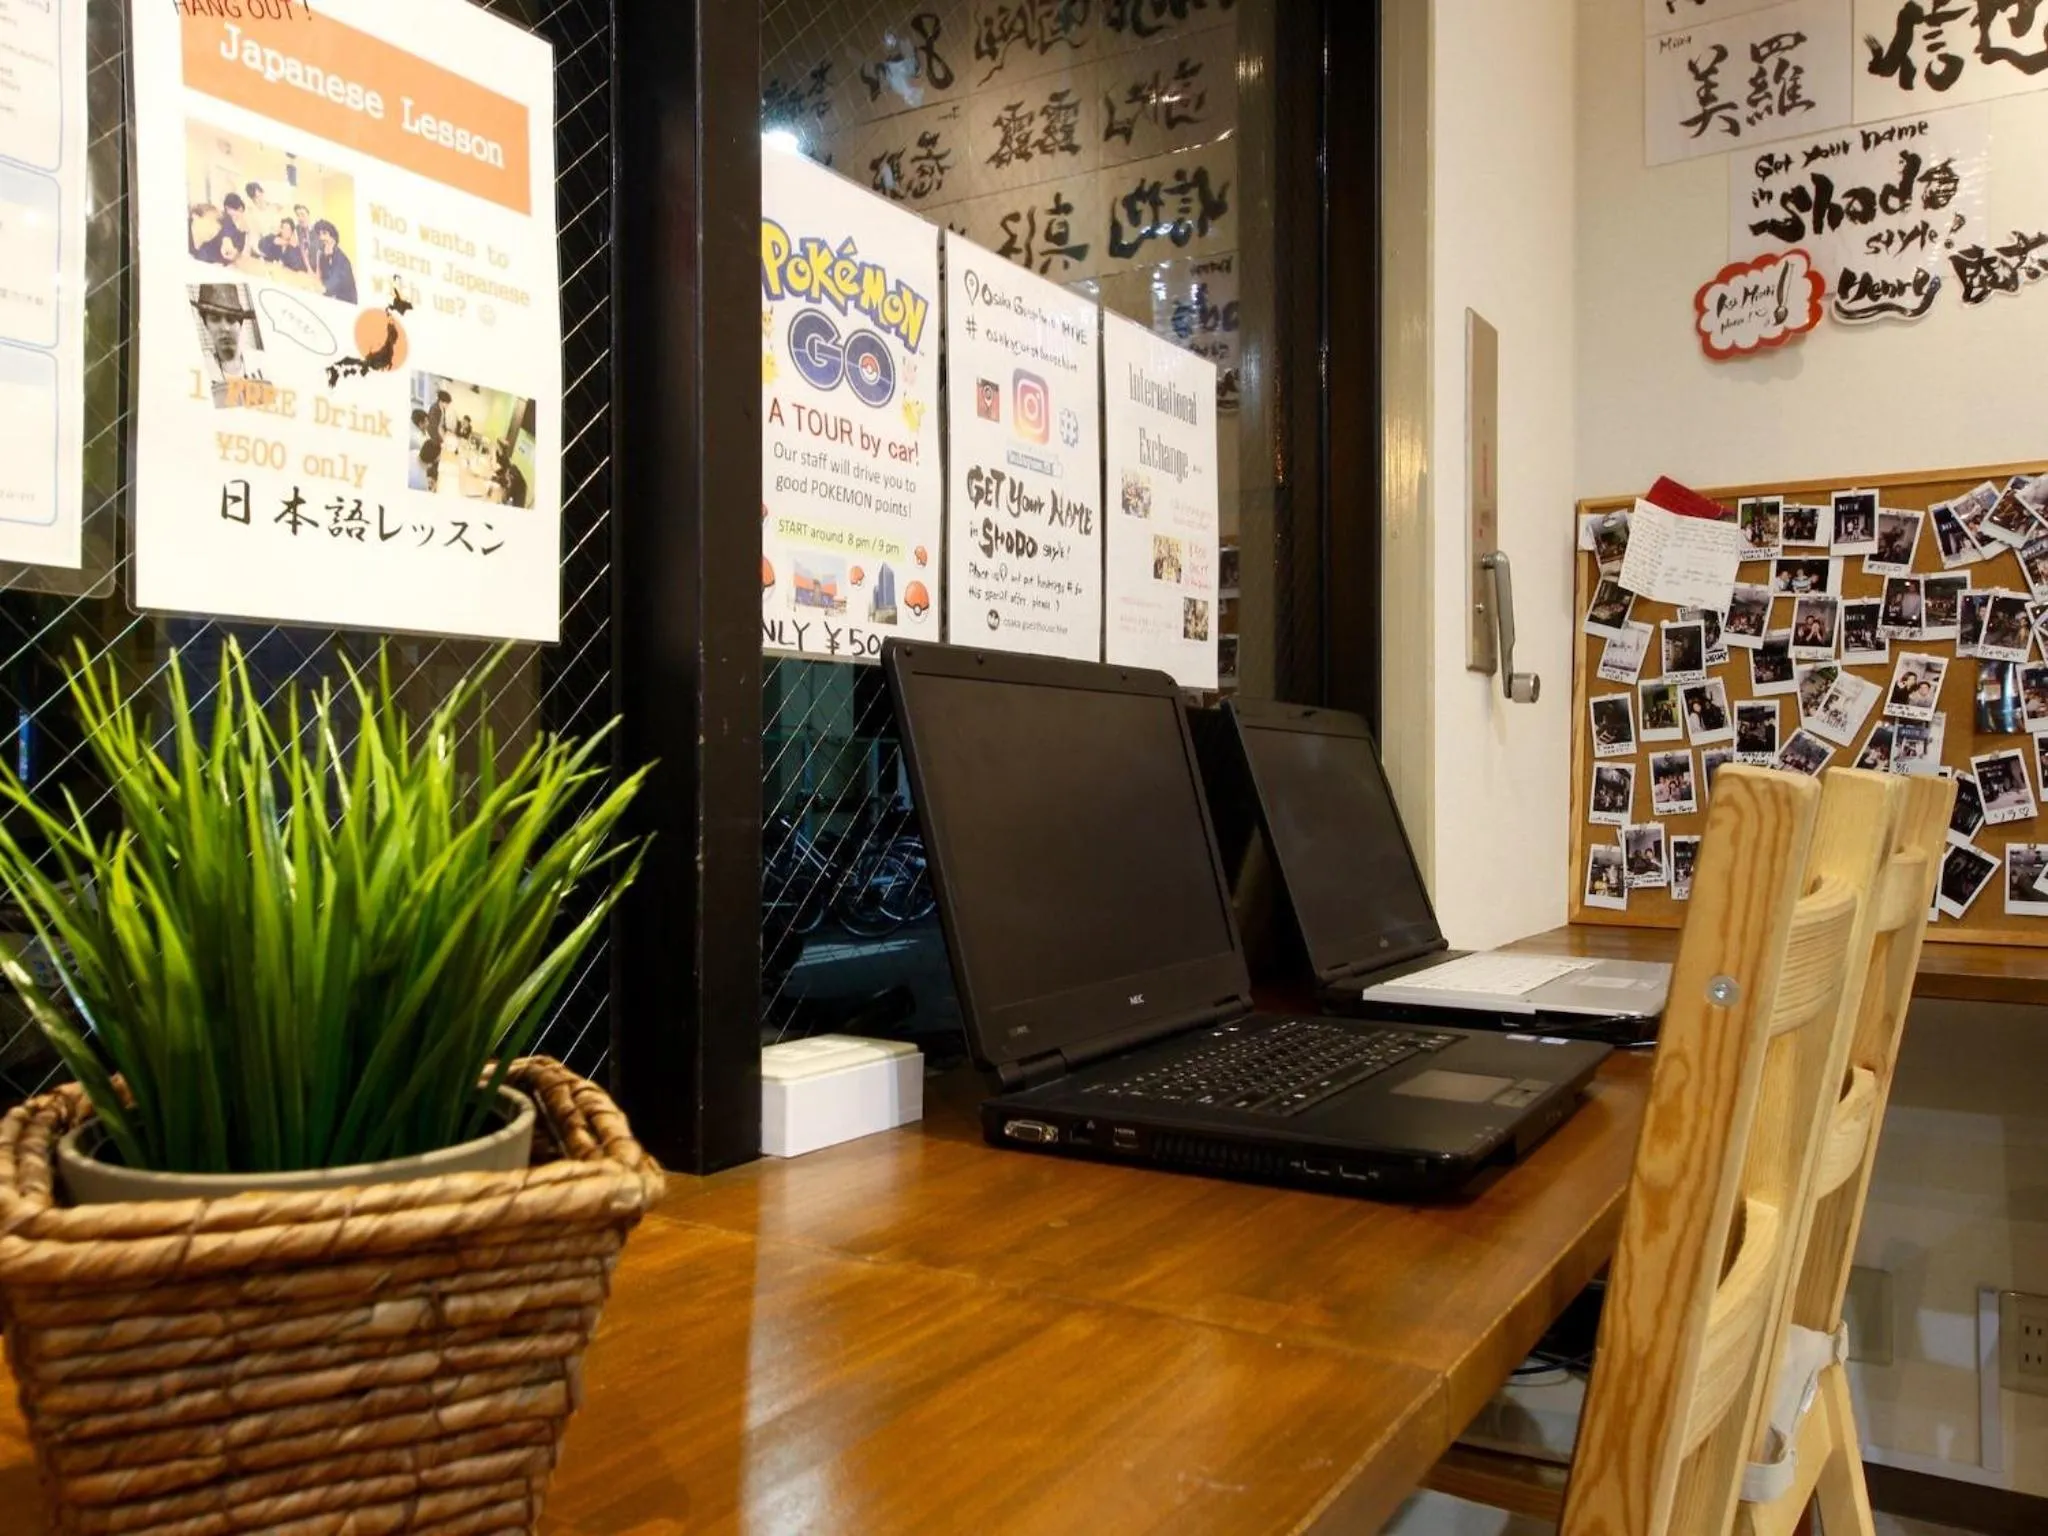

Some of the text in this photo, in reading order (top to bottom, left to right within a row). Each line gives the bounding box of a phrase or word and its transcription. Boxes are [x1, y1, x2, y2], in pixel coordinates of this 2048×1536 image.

[219, 22, 505, 169] Japanese Lesson
[1755, 119, 1930, 182] Get your name
[369, 202, 511, 270] Who wants to
[372, 237, 531, 307] learn Japanese
[433, 293, 467, 317] us?
[1061, 320, 1087, 346] HIVE
[787, 308, 897, 410] GO
[190, 368, 393, 438] 1 FREE Drink
[1128, 362, 1198, 426] International
[216, 431, 368, 489] ¥500 only
[768, 397, 919, 467] A TOUR by car!
[1138, 427, 1189, 484] Exchange
[773, 441, 916, 493] Our staff will drive you to
[775, 475, 912, 519] good POKEMON points!
[220, 479, 506, 556] 日本語レッスン
[778, 518, 808, 535] START
[810, 527, 844, 544] around
[967, 465, 1093, 536] GET Your NAME
[978, 517, 1039, 559] SHODO
[761, 619, 811, 652] NLY
